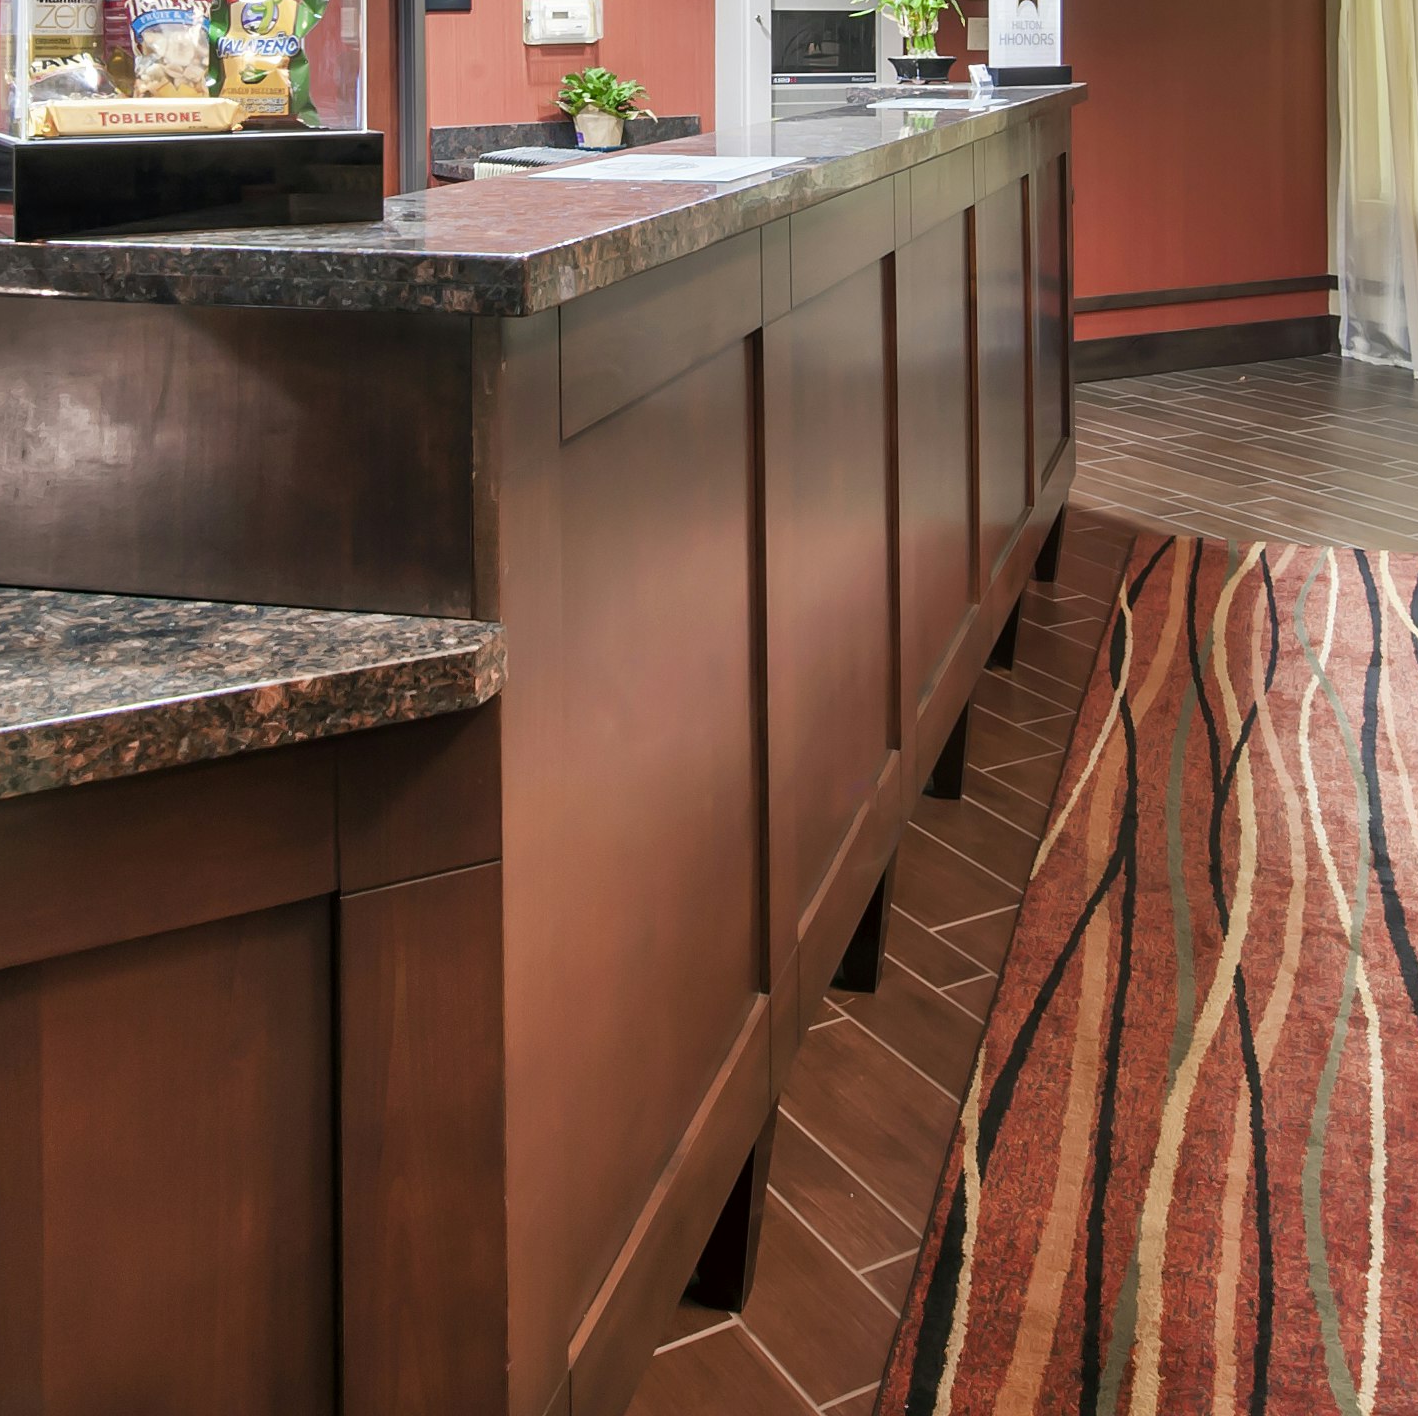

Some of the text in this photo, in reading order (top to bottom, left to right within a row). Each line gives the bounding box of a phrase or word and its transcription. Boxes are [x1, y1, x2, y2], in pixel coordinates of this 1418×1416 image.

[36, 4, 98, 29] zero
[141, 11, 170, 24] FRUIT
[217, 32, 300, 57] JALAPEÑO
[999, 33, 1055, 46] HHONORS
[98, 111, 202, 127] TOBLERONE
